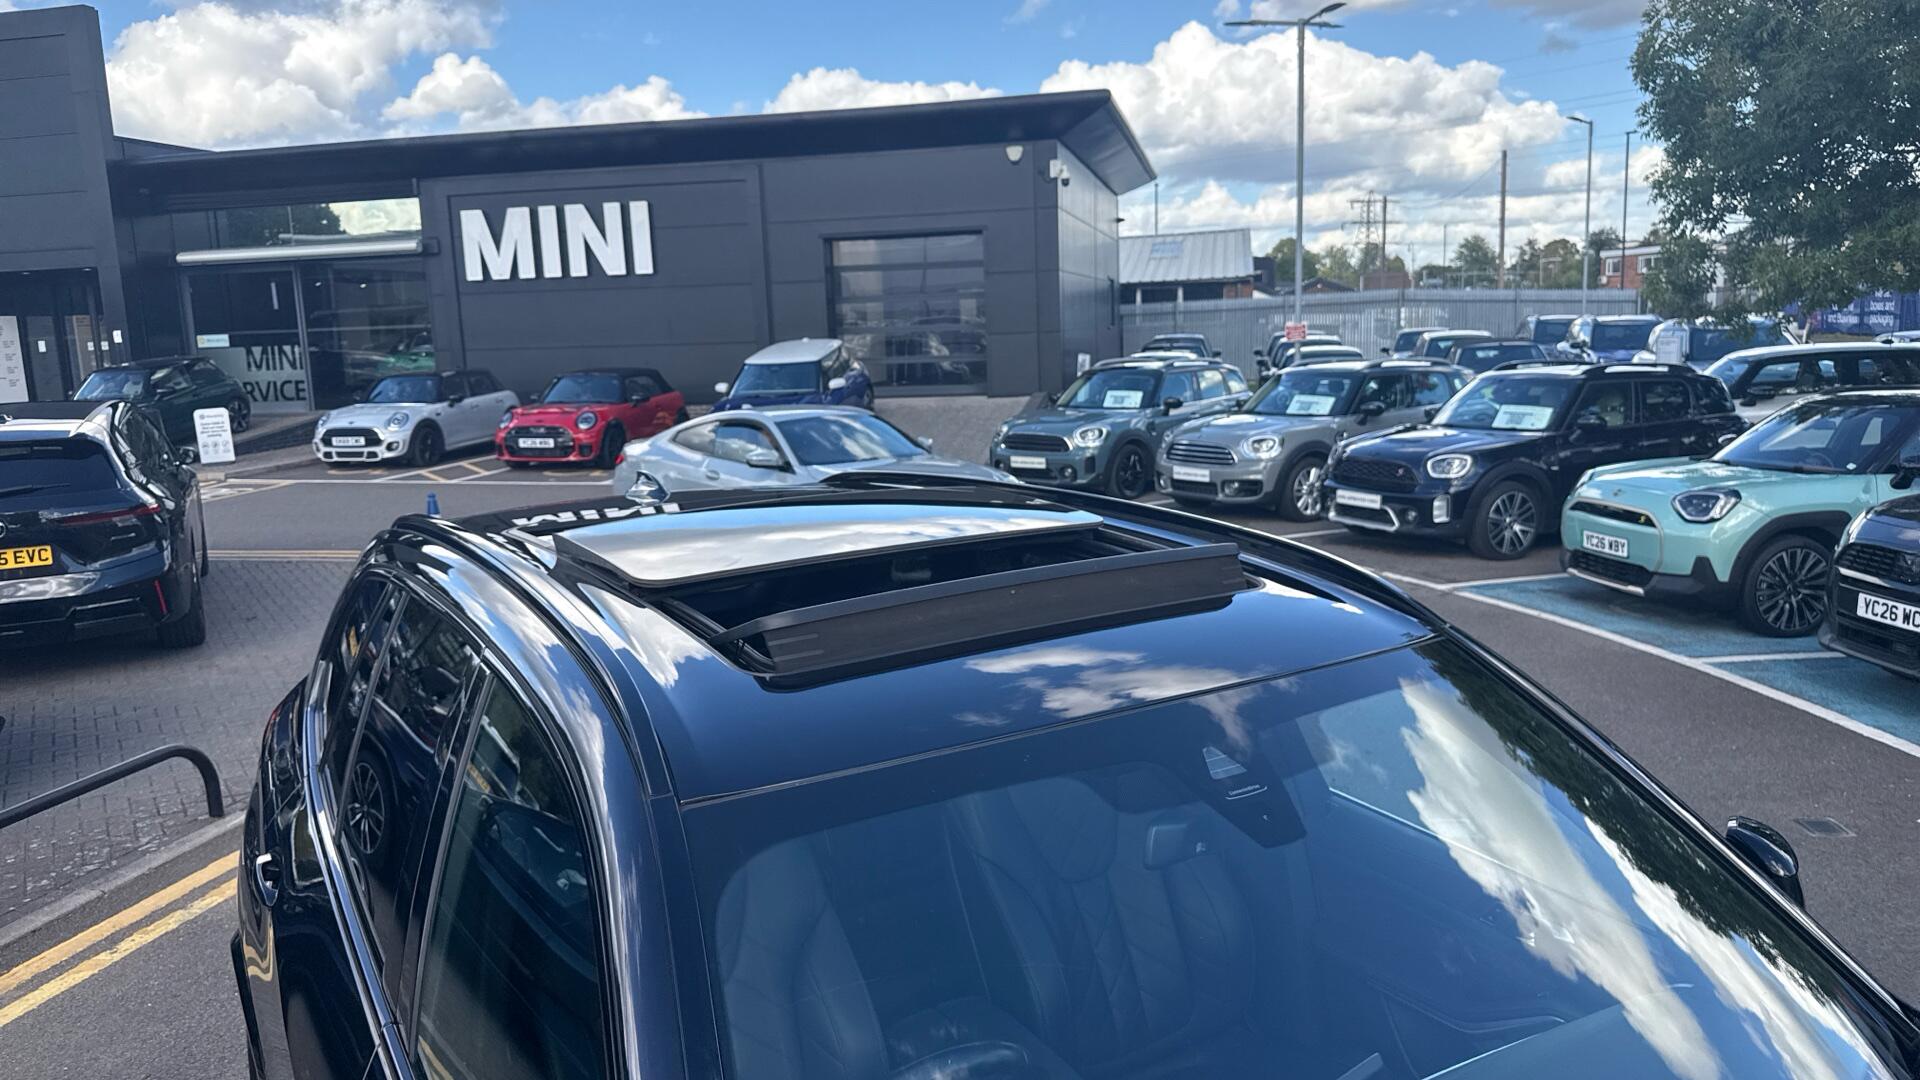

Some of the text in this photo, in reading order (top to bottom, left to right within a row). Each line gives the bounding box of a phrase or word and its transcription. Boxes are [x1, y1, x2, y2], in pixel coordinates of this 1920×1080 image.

[459, 200, 654, 281] MINI
[245, 345, 304, 372] MINI
[242, 380, 307, 402] RVICE
[1585, 533, 1626, 554] YC26 WBY
[13, 548, 49, 564] EVC
[1864, 597, 1920, 628] YC26 WC
